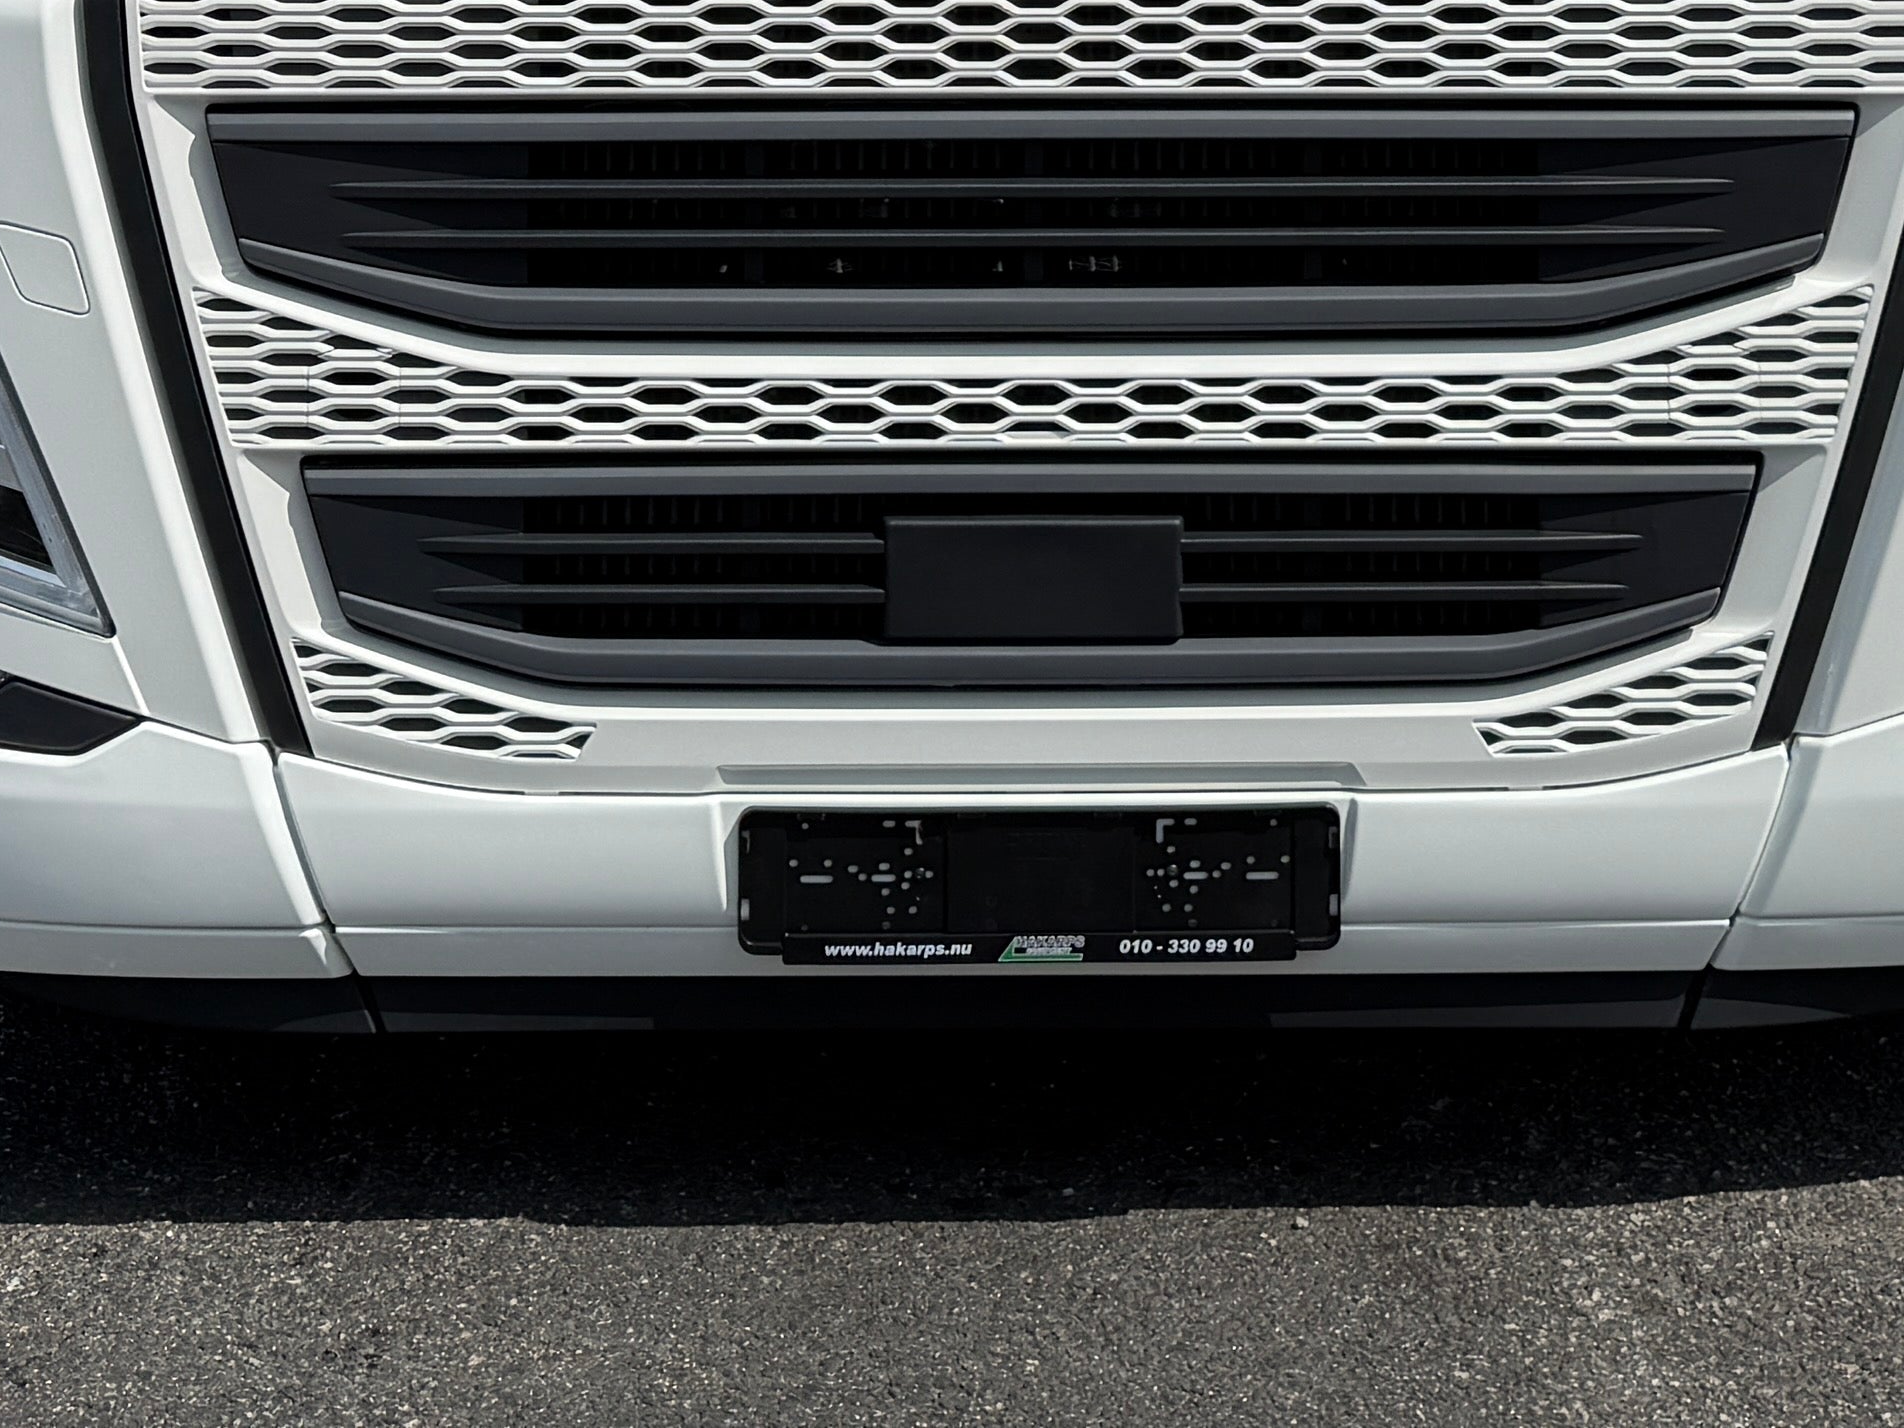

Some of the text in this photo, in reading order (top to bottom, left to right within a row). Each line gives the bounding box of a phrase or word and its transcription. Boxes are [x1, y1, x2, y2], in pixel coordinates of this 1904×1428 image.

[824, 942, 973, 958] www.hakarps.nu
[1119, 939, 1153, 954] 010
[1167, 939, 1201, 953] 330
[1205, 939, 1227, 953] 99
[1233, 938, 1255, 953] 10
